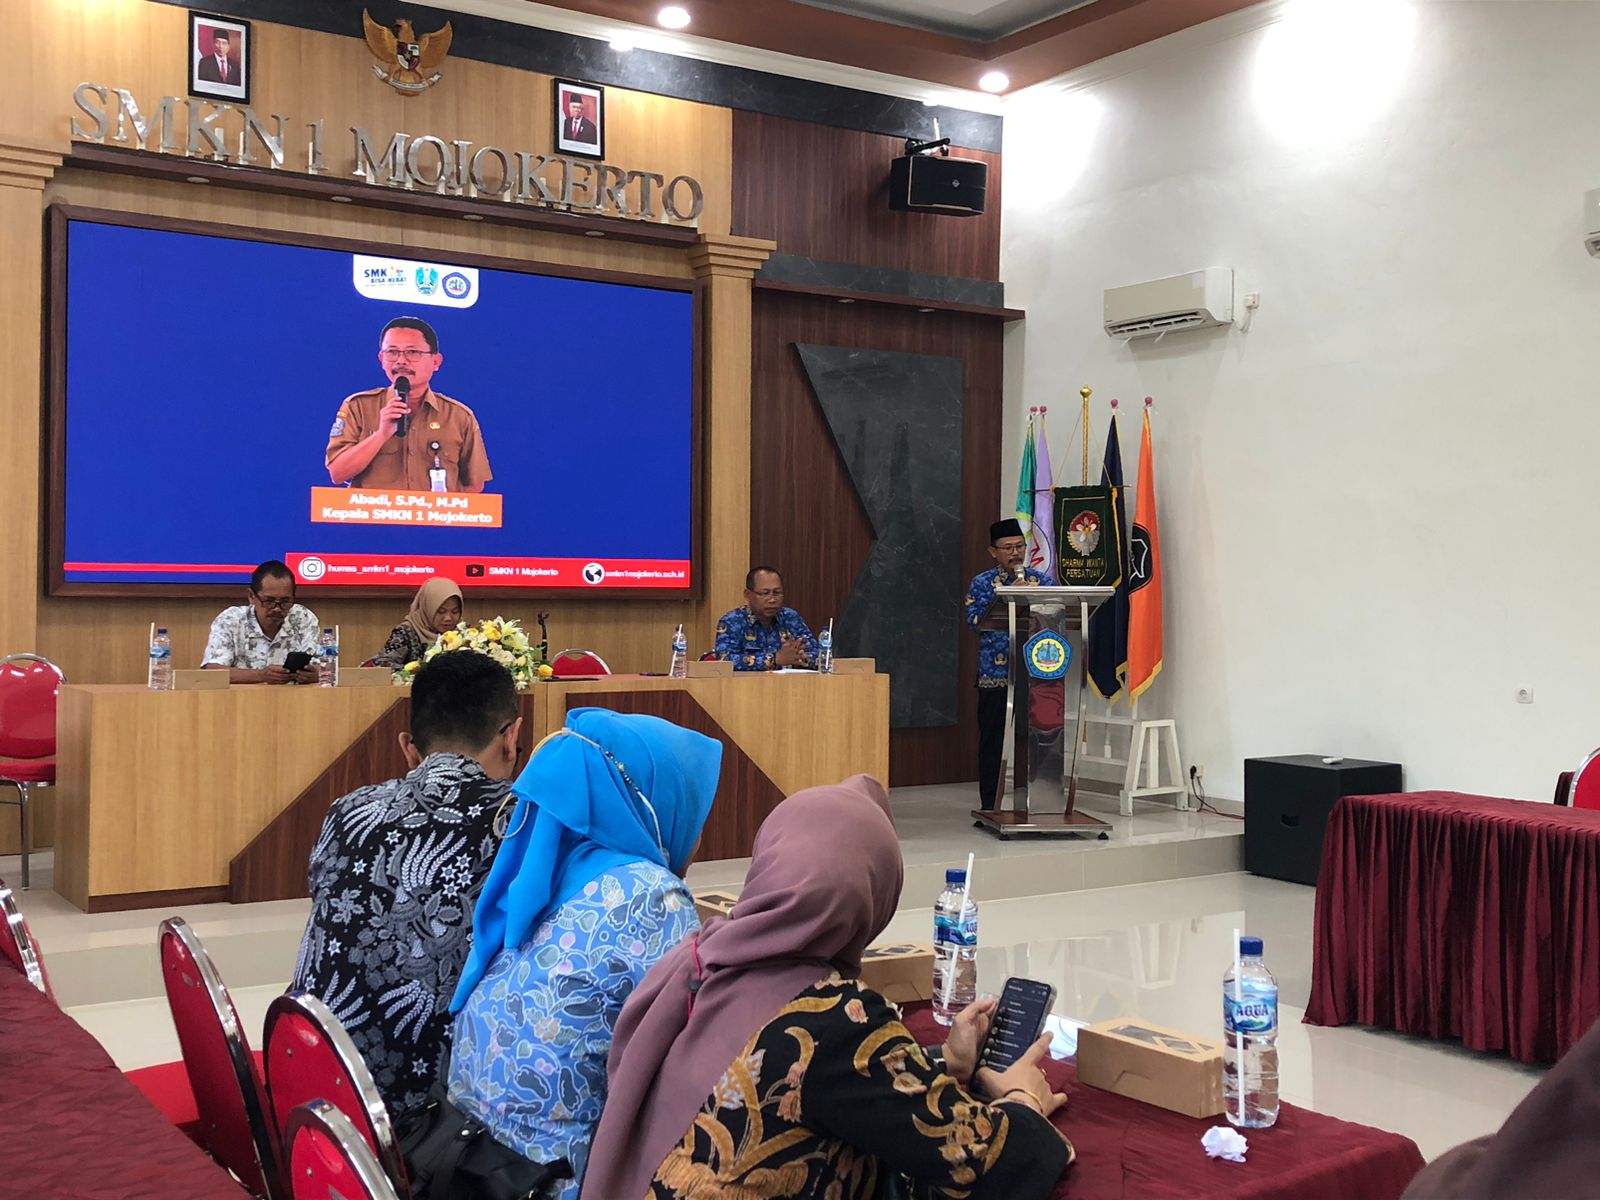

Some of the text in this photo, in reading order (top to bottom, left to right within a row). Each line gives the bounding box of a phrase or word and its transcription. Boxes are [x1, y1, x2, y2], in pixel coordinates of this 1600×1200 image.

[71, 82, 704, 222] SMKN 1 MOJOKERTO
[364, 268, 387, 278] SMK
[349, 493, 469, 508] Abadi, S.Pd., M.Pd
[322, 507, 493, 523] Kepala SMKN 1 Mojokerto
[489, 567, 559, 577] SMKN 1 Mojokerto
[1236, 1004, 1269, 1018] AQUA
